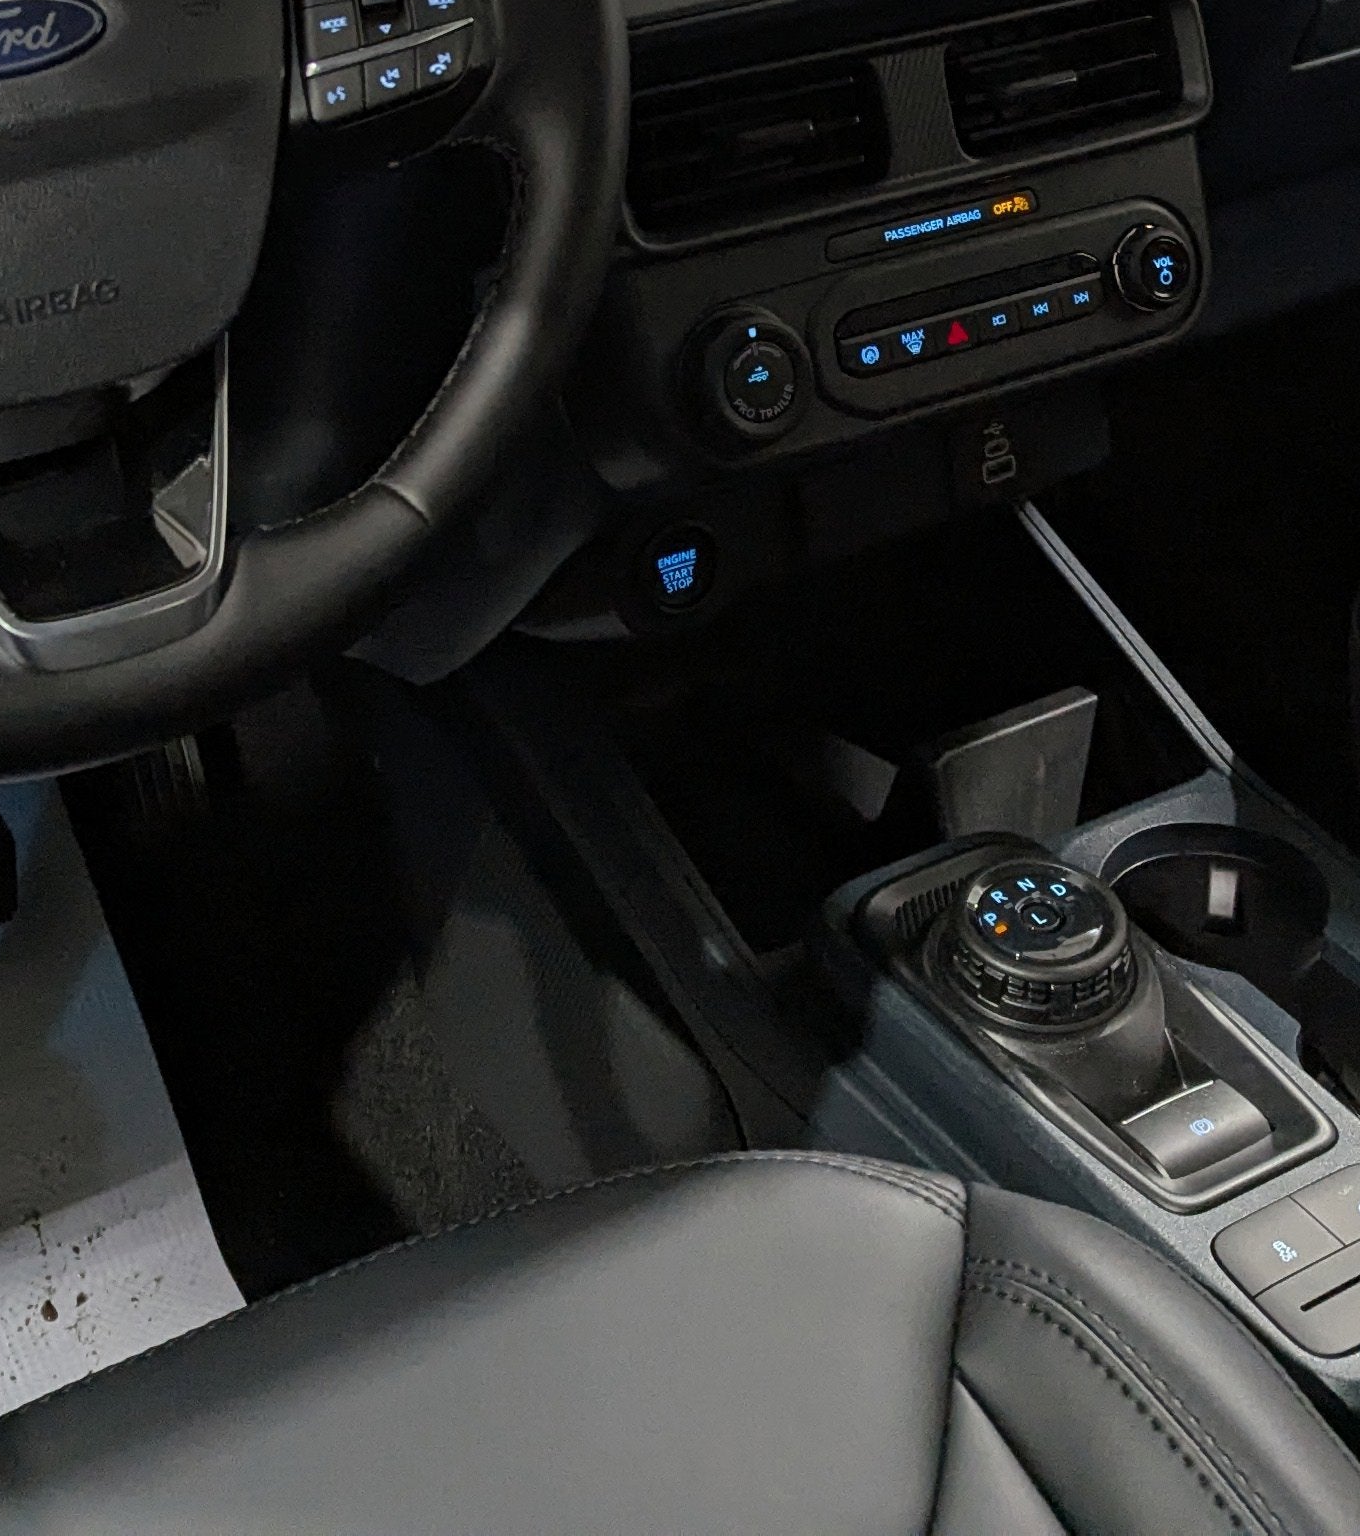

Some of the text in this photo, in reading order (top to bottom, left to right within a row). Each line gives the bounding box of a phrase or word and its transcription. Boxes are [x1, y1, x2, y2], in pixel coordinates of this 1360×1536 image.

[319, 16, 347, 30] MODE
[884, 201, 1014, 242] PASSENGER AIRBAG OFF
[1152, 256, 1174, 269] VOL
[901, 329, 925, 344] MAX
[733, 384, 794, 420] PRO TRAILER
[658, 548, 697, 569] ENGINE
[662, 566, 695, 584] START
[666, 576, 694, 594] STOP
[1016, 878, 1036, 892] N
[1050, 884, 1067, 897] D
[990, 890, 1009, 904] R
[983, 912, 997, 927] P
[1031, 913, 1048, 925] L
